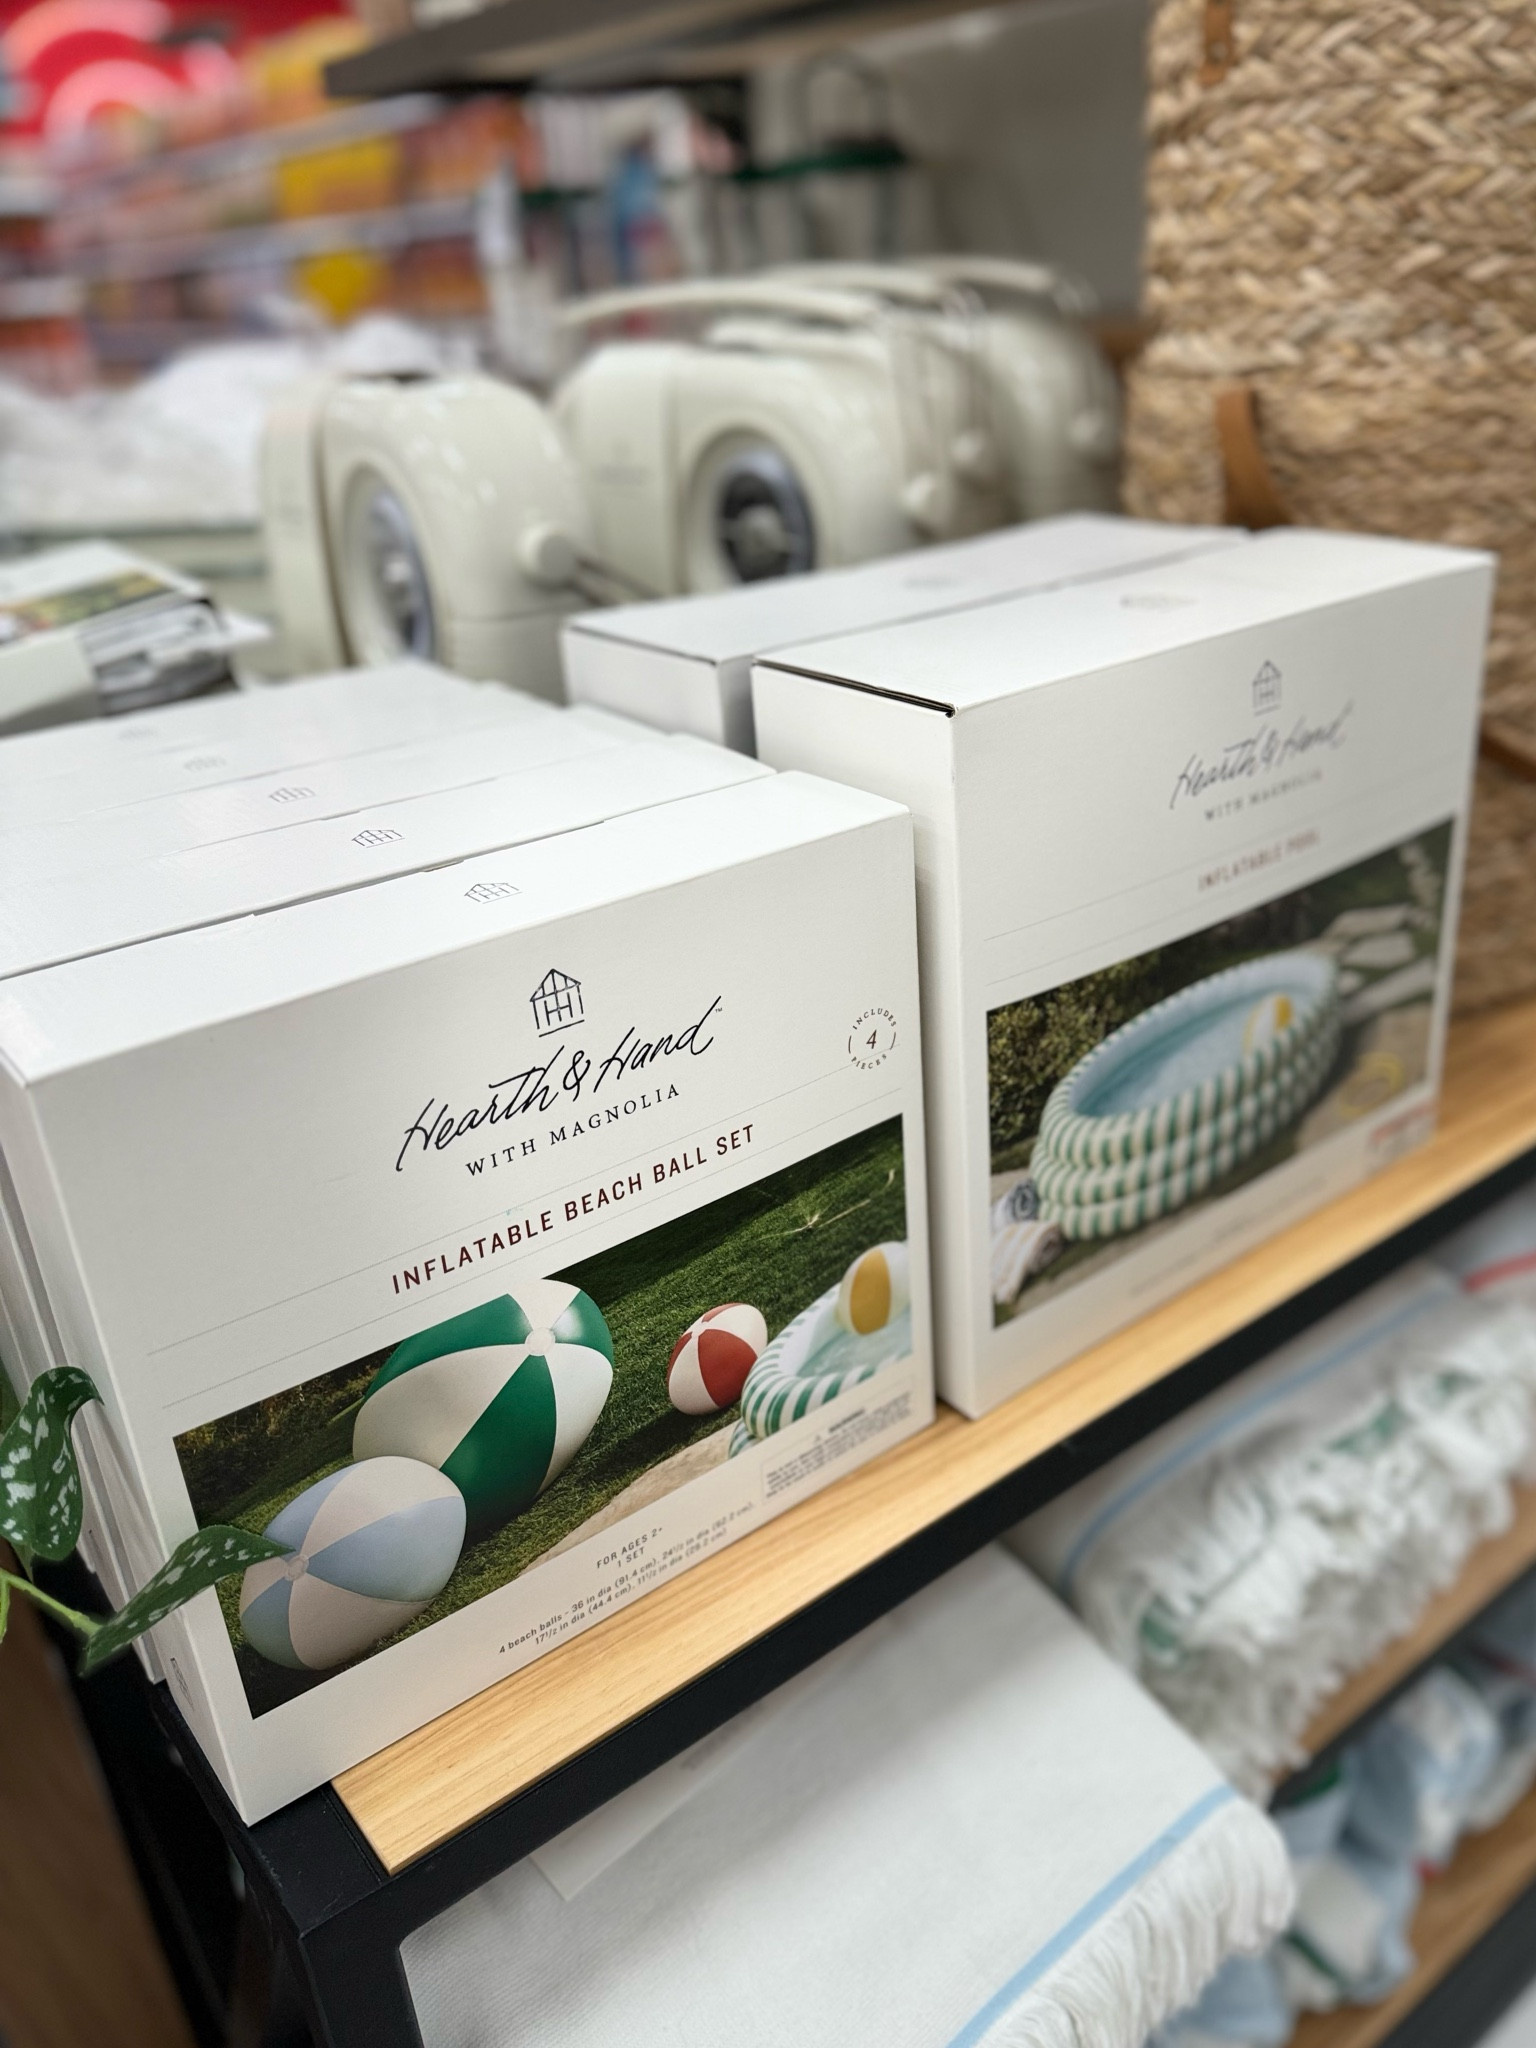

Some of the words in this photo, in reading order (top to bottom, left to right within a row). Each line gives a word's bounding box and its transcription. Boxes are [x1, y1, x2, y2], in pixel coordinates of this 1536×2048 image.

[852, 1007, 897, 1031] INCLUDES
[865, 1028, 878, 1050] 4
[395, 1045, 565, 1172] Hearth
[562, 1050, 592, 1102] &
[465, 1138, 537, 1176] WITH
[549, 1083, 680, 1145] MAGNOLIA
[392, 1210, 554, 1295] INFLATABLE
[564, 1172, 643, 1222] BEACH
[653, 1146, 708, 1185] BALL
[716, 1123, 755, 1157] SET
[596, 1551, 618, 1569] FOR
[621, 1534, 648, 1555] AGES
[625, 1546, 645, 1563] SET
[508, 1627, 538, 1650] beach
[539, 1614, 562, 1632] balls
[571, 1600, 585, 1613] 36
[586, 1594, 596, 1605] in
[597, 1585, 612, 1598] dia
[559, 1621, 569, 1631] in
[571, 1611, 586, 1624] dia
[588, 1594, 612, 1615] (44.4
